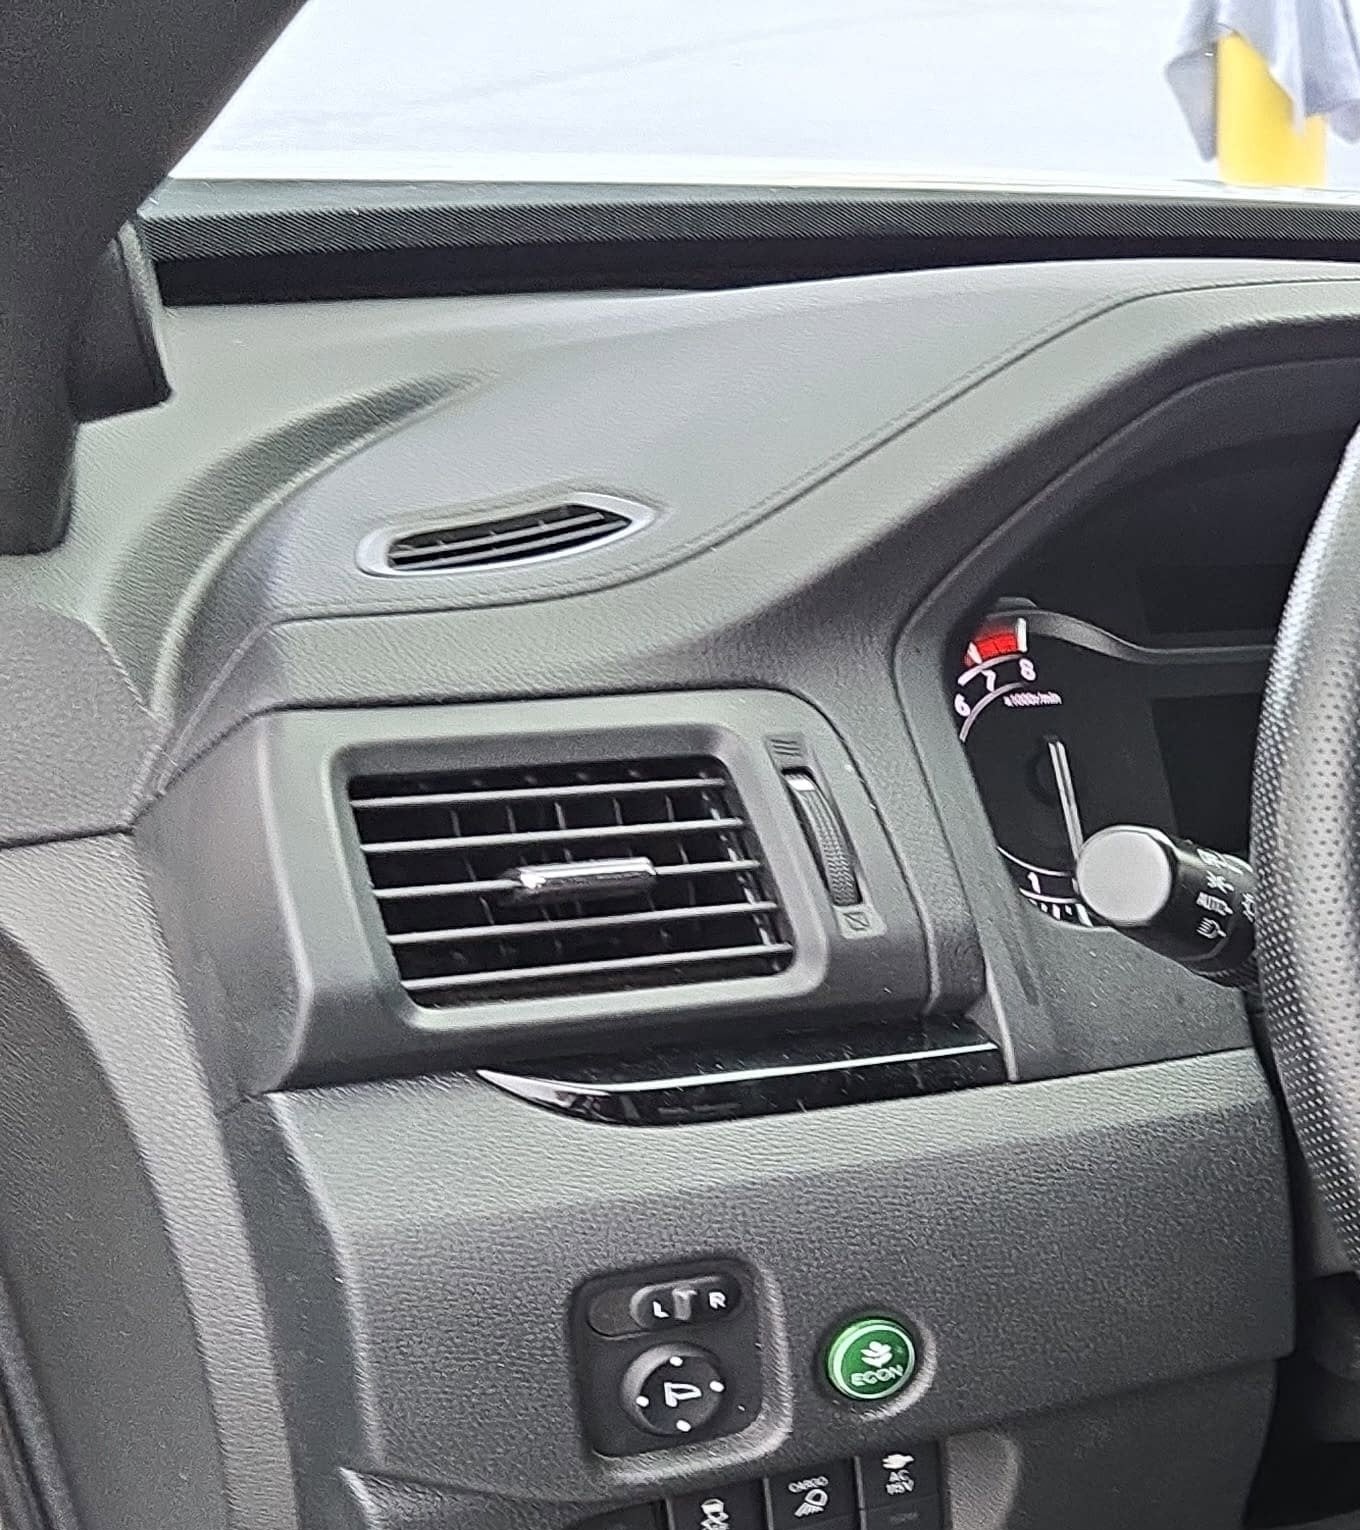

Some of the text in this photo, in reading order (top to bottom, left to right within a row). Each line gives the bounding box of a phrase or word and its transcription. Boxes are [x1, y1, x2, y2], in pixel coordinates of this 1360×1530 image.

[980, 668, 997, 692] 7
[1018, 657, 1037, 681] 8
[953, 692, 971, 717] 6
[1026, 871, 1041, 894] 1
[652, 1291, 727, 1319] L R
[850, 1364, 905, 1387] ECON
